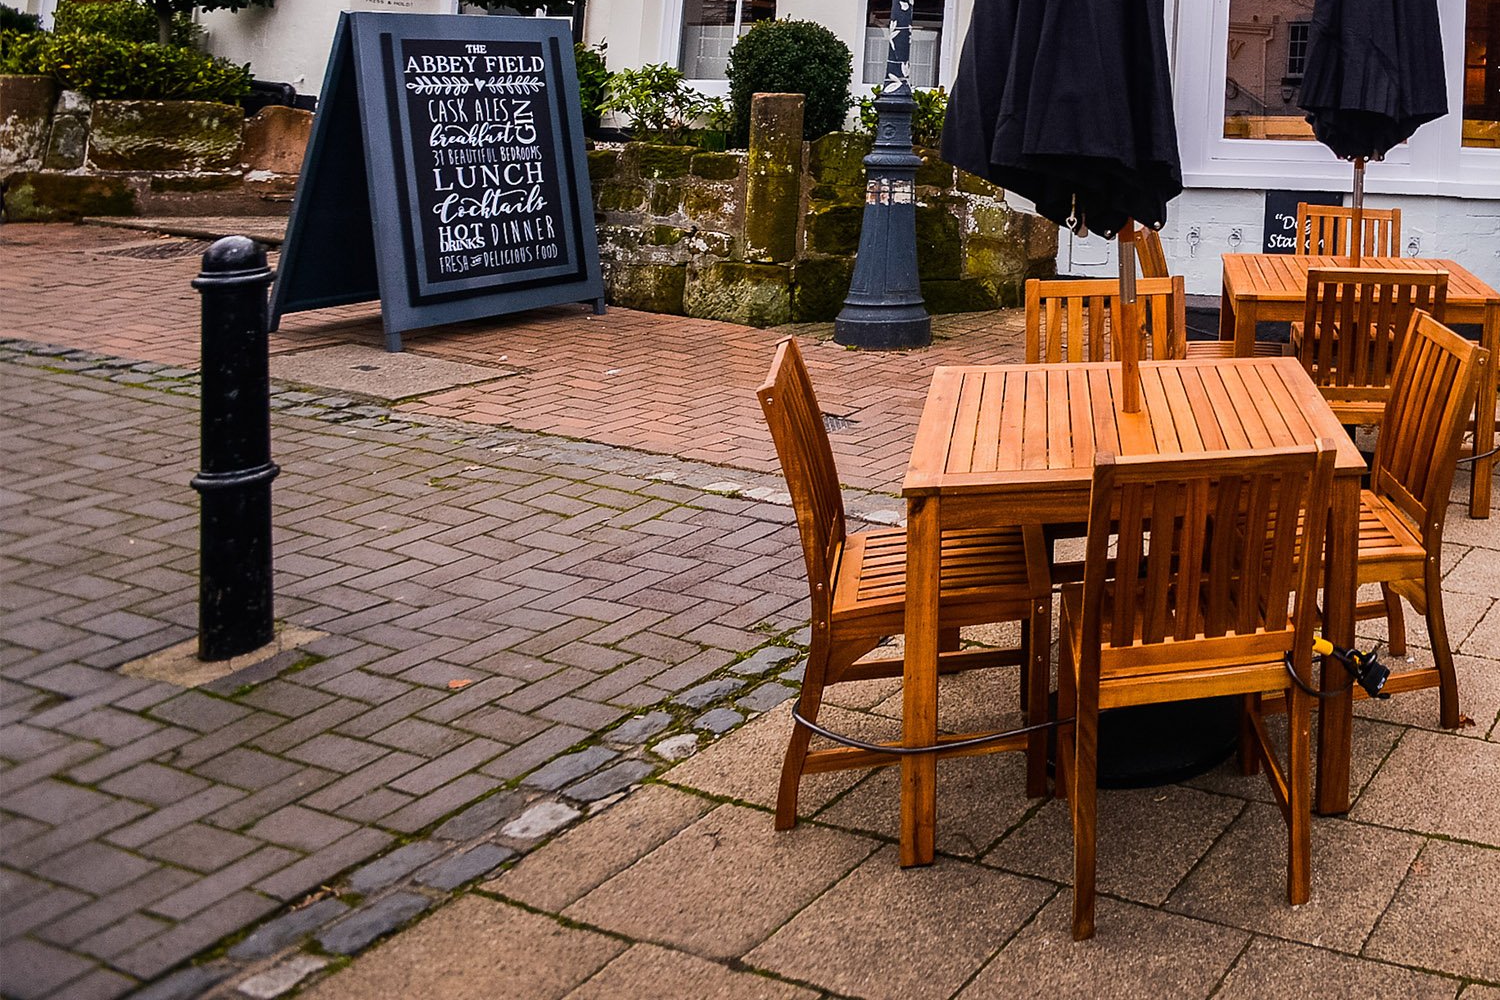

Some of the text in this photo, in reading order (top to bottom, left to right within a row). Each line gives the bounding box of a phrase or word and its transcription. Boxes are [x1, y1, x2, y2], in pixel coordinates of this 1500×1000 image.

[465, 44, 487, 54] THE
[404, 56, 544, 73] ABBEY FIELD
[428, 98, 508, 123] CASK ALES
[512, 99, 537, 144] GIN
[430, 121, 514, 147] breakfast
[432, 146, 542, 166] 31 BEAUTIFUL BEDROOMS
[433, 162, 544, 191] LUNCH
[432, 184, 548, 224] Cocktails
[438, 216, 555, 246] HOT DINNER
[440, 237, 485, 252] DRINKS
[440, 255, 469, 273] FRESH
[484, 246, 532, 267] DELICIOUS
[536, 243, 558, 259] FOOD
